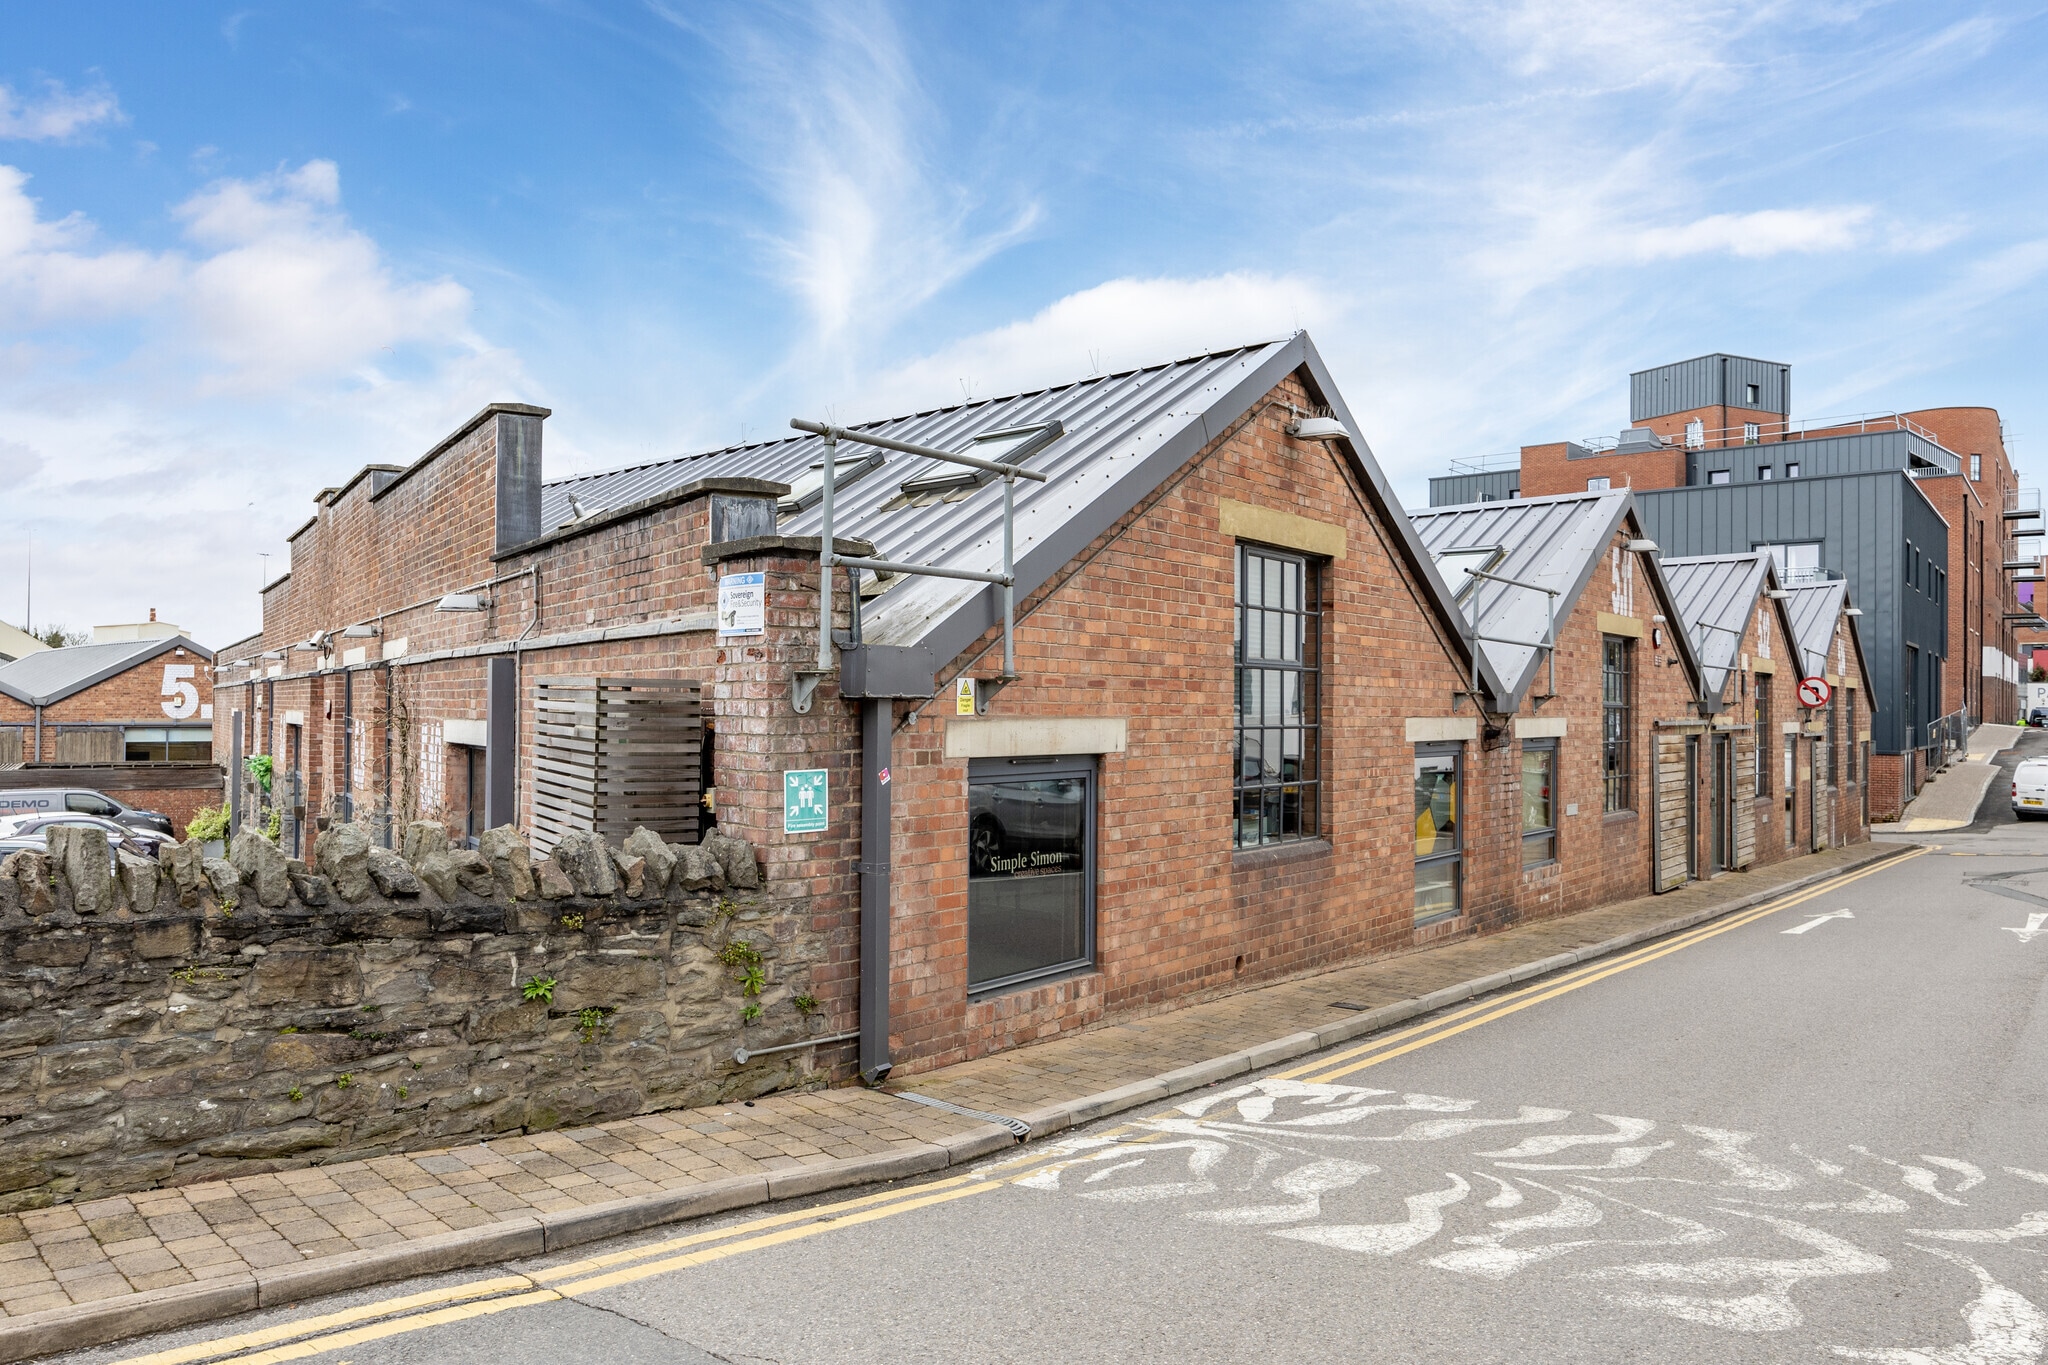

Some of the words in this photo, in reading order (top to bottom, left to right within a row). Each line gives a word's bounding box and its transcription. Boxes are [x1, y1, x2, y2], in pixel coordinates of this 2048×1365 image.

[730, 590, 754, 600] Sovereign
[0, 799, 49, 808] DEMO
[990, 852, 1027, 873] Simple
[1030, 851, 1063, 867] Simon
[1014, 867, 1039, 878] creative
[1040, 865, 1062, 876] spaces
